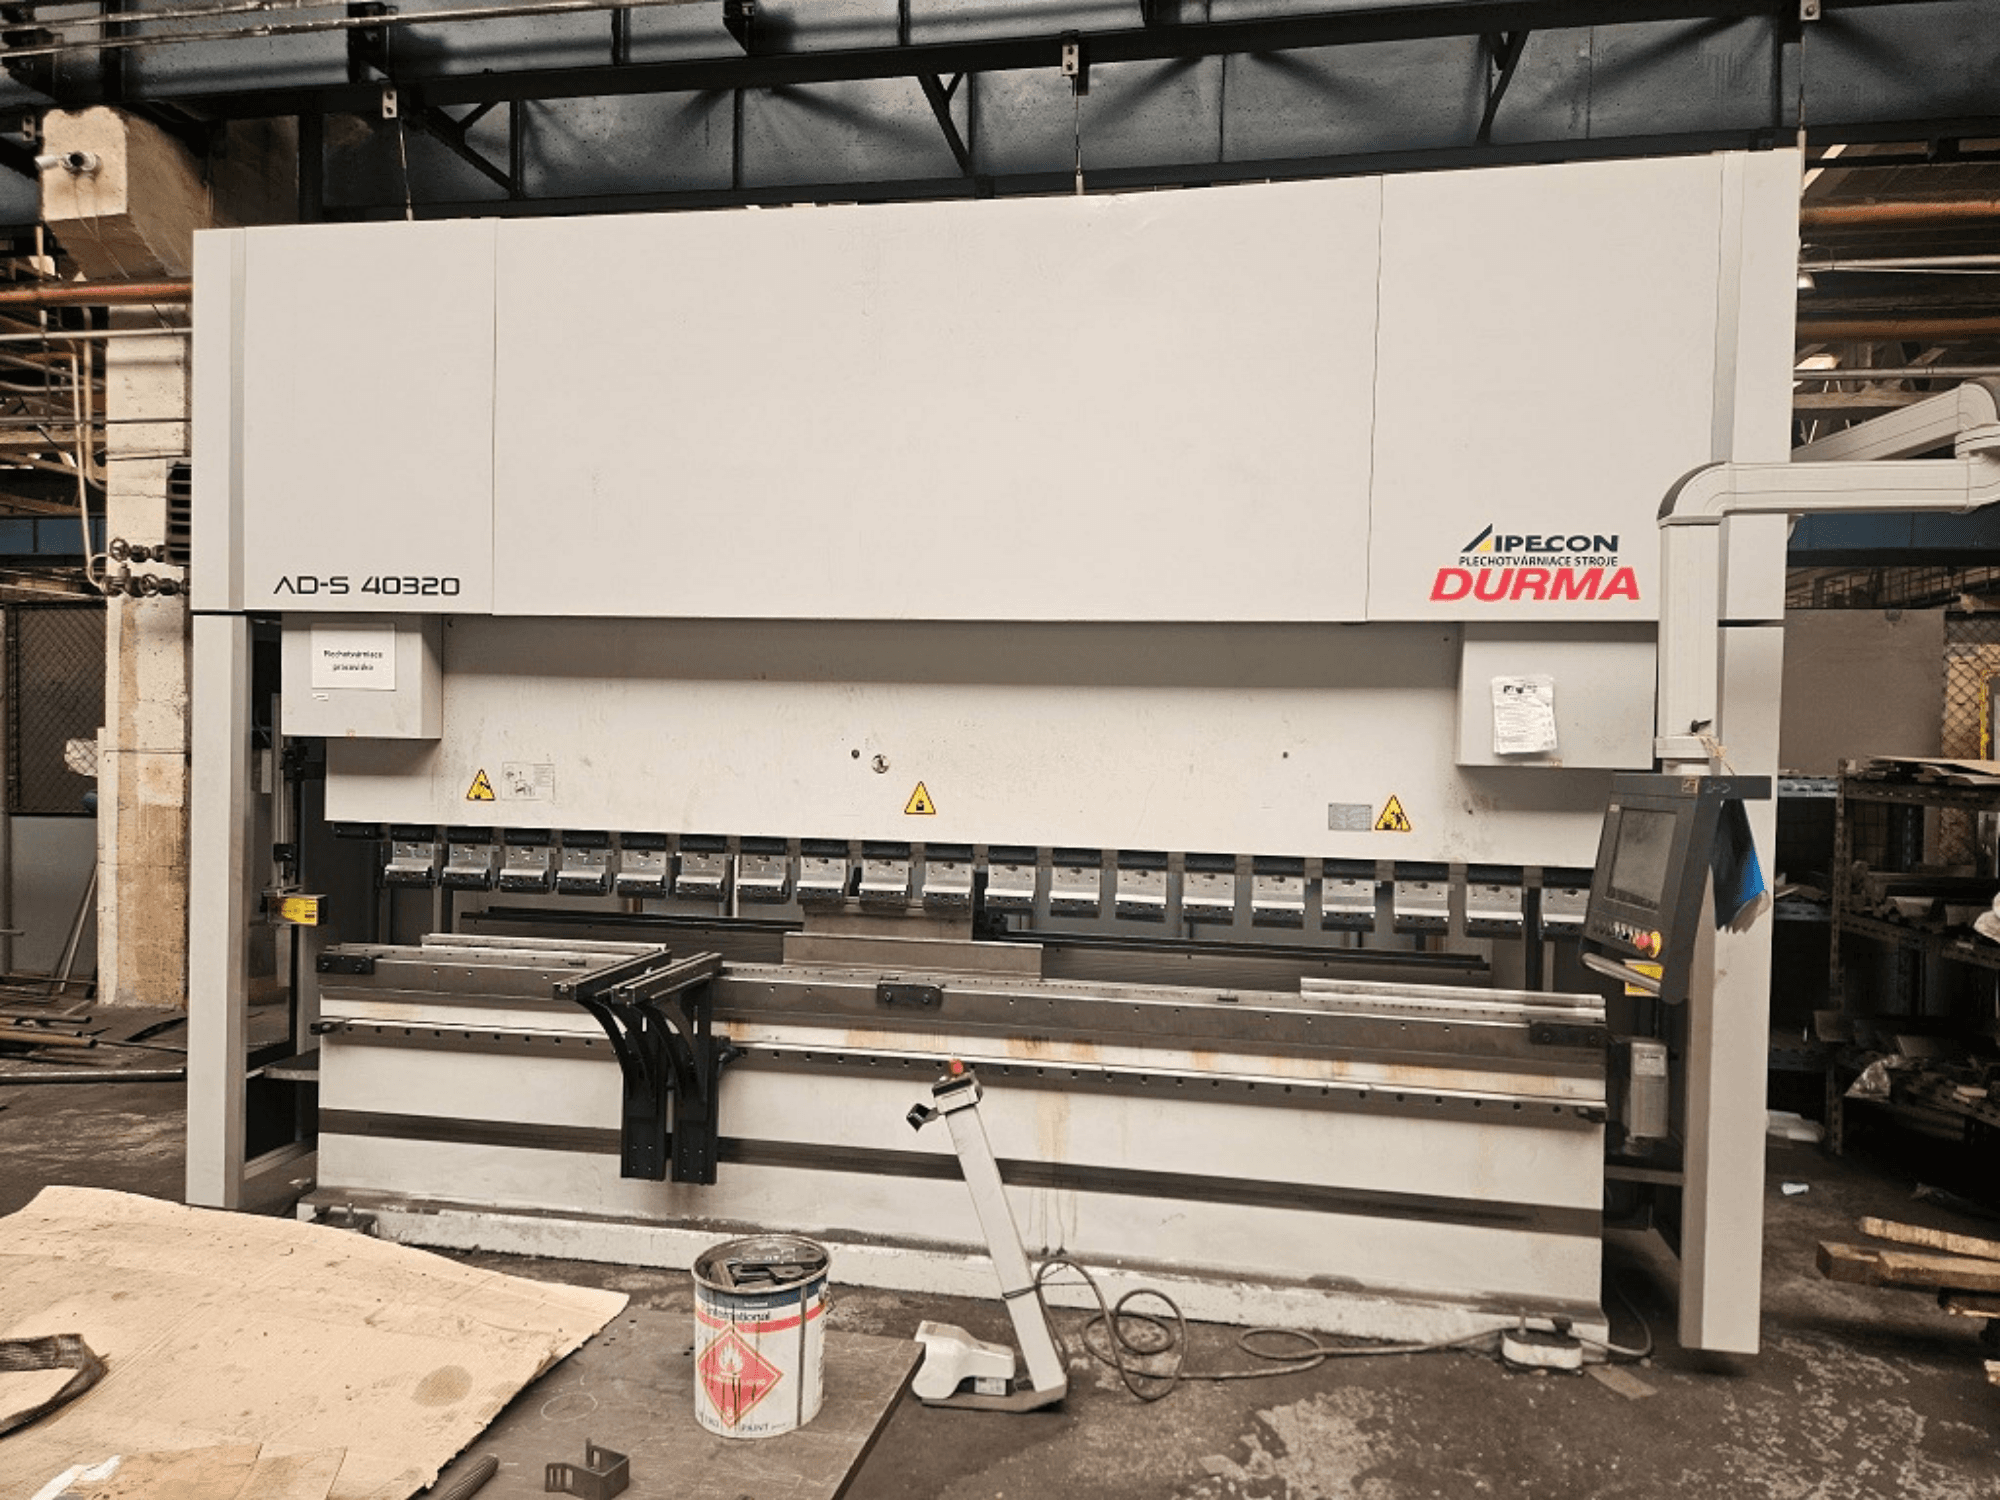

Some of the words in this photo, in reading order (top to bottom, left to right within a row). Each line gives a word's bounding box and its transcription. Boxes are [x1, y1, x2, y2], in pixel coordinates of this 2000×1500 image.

[1574, 556, 1618, 566] STROJE
[273, 576, 349, 595] AD-S
[361, 576, 460, 596] 40320
[1430, 567, 1641, 602] DURMA
